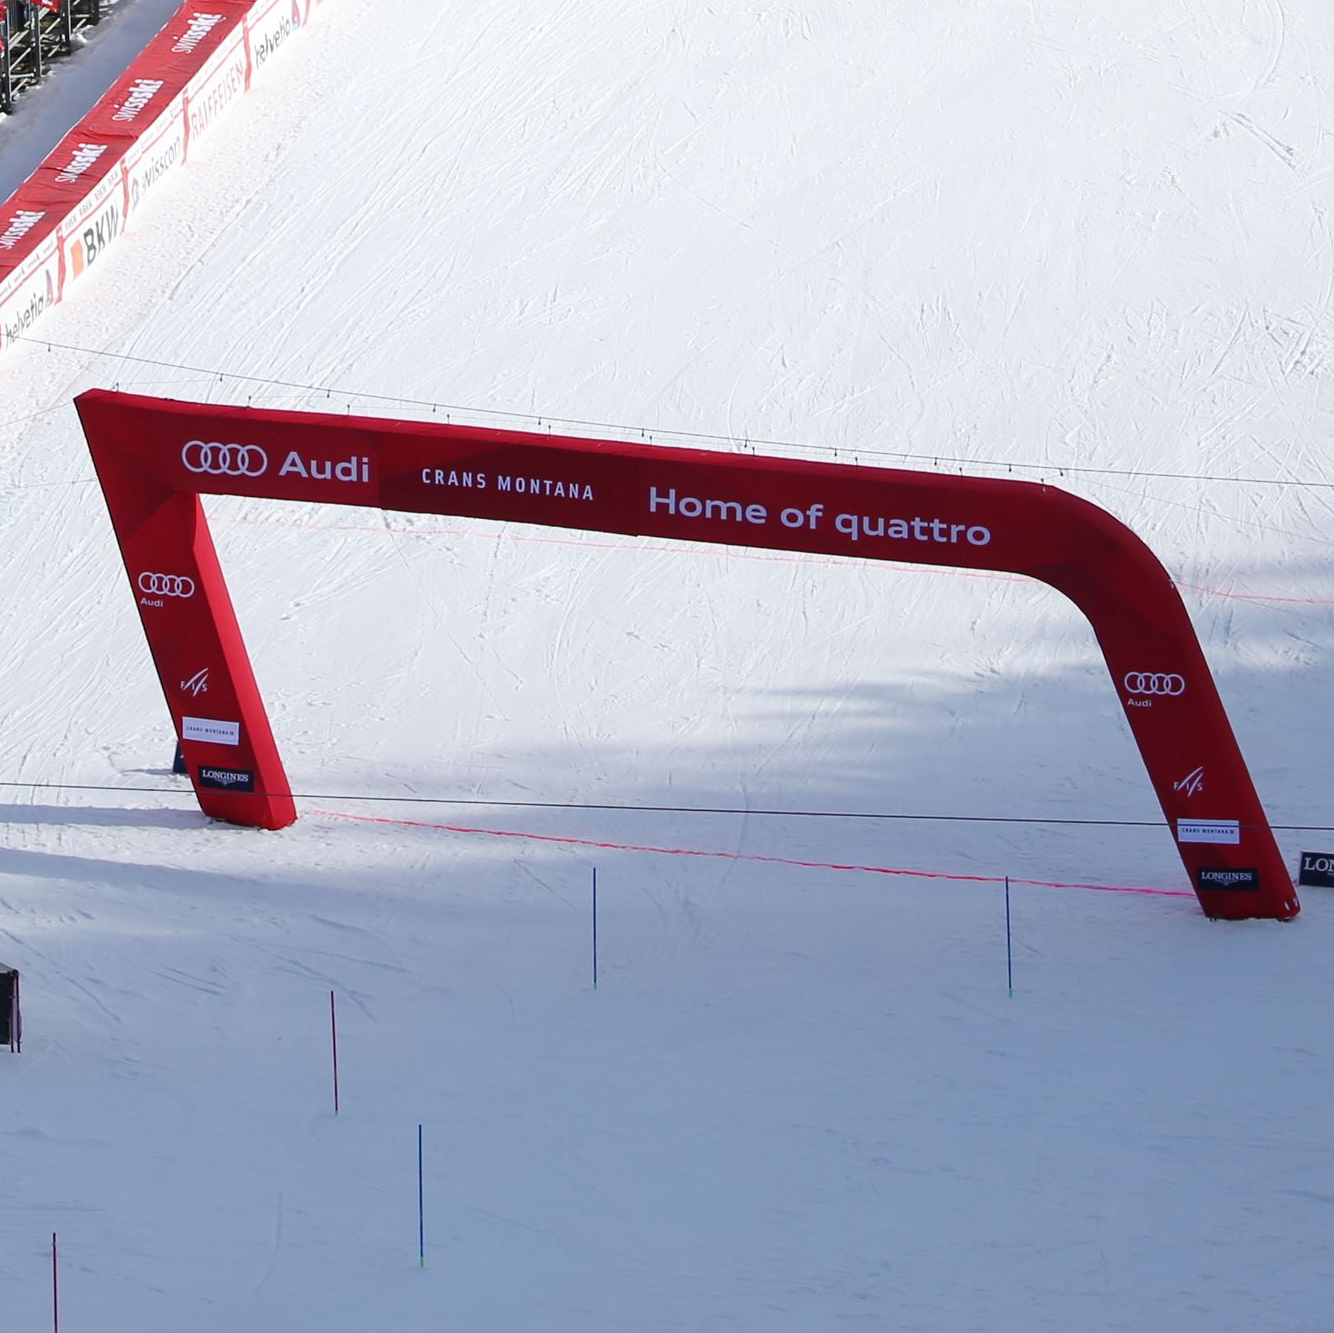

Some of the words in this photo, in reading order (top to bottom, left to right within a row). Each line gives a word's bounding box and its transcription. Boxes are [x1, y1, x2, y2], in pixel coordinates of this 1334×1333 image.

[171, 12, 222, 54] swissski
[113, 78, 163, 122] swissski
[191, 58, 244, 142] RAIFFEISEN
[55, 143, 108, 184] swissski
[83, 203, 119, 266] BKW
[278, 452, 369, 483] Audi
[421, 467, 487, 490] CRANS
[497, 476, 594, 501] MONTANA
[649, 485, 768, 525] Home
[779, 503, 825, 530] of
[835, 512, 992, 548] quattro
[140, 596, 164, 608] Audi
[1127, 698, 1152, 708] Audi
[201, 768, 249, 784] LONGINES
[1201, 871, 1253, 882] LONGINES
